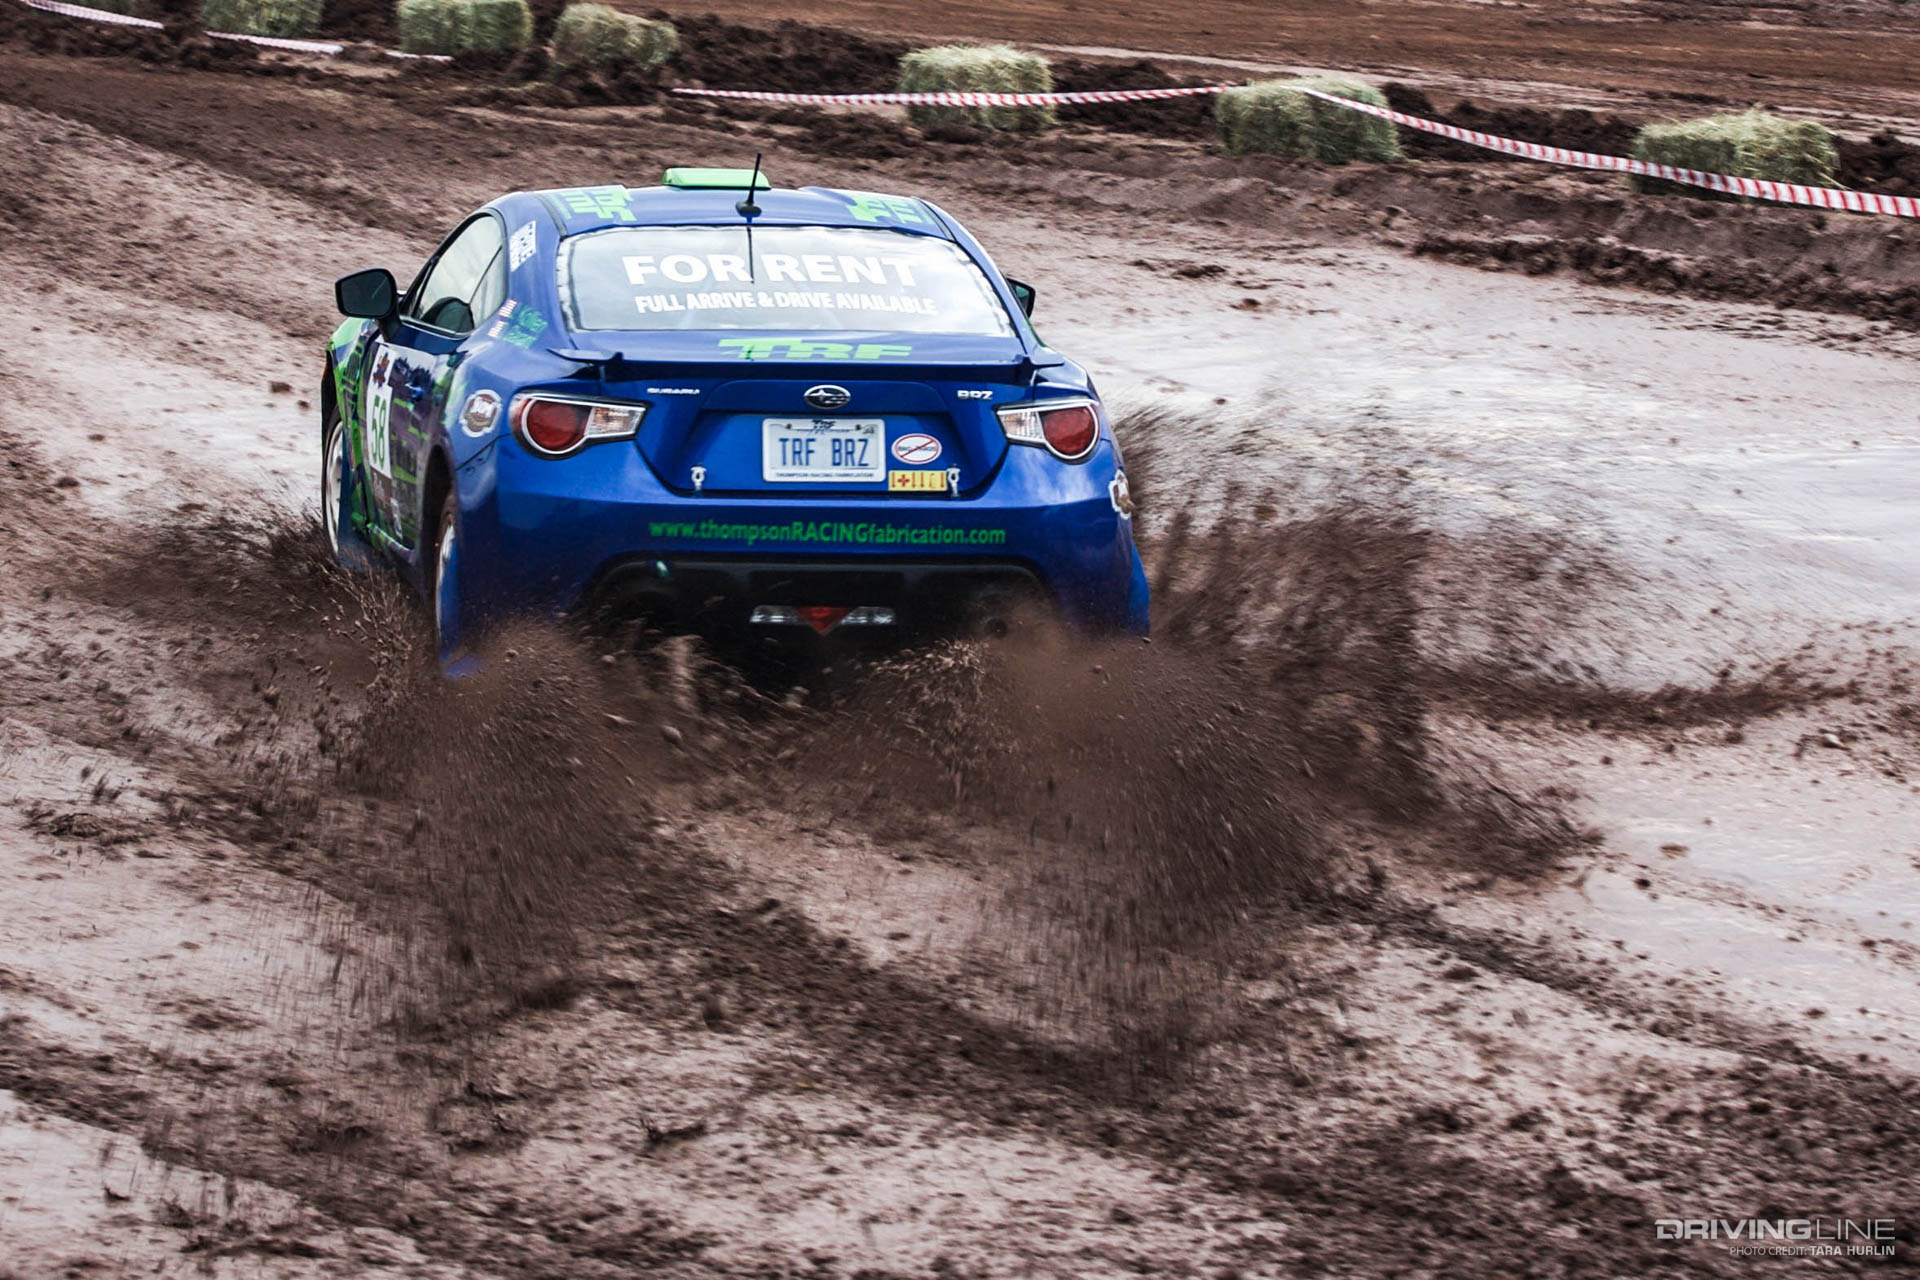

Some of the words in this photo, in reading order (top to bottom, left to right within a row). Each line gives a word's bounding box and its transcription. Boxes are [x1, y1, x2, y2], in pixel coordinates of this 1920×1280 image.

[622, 254, 753, 284] FOR
[761, 254, 920, 286] RENT
[635, 294, 685, 313] FULL
[687, 292, 757, 309] ARRIVE
[758, 291, 774, 308] &
[774, 292, 834, 308] DRIVE
[836, 293, 937, 315] AVAILABLE
[718, 338, 912, 360] TRF
[957, 390, 993, 400] BRZ
[372, 395, 387, 470] 58
[779, 438, 816, 466] TRF
[831, 438, 869, 466] BRZ
[649, 519, 1006, 546] www.thompsonRACINGfabrication.com
